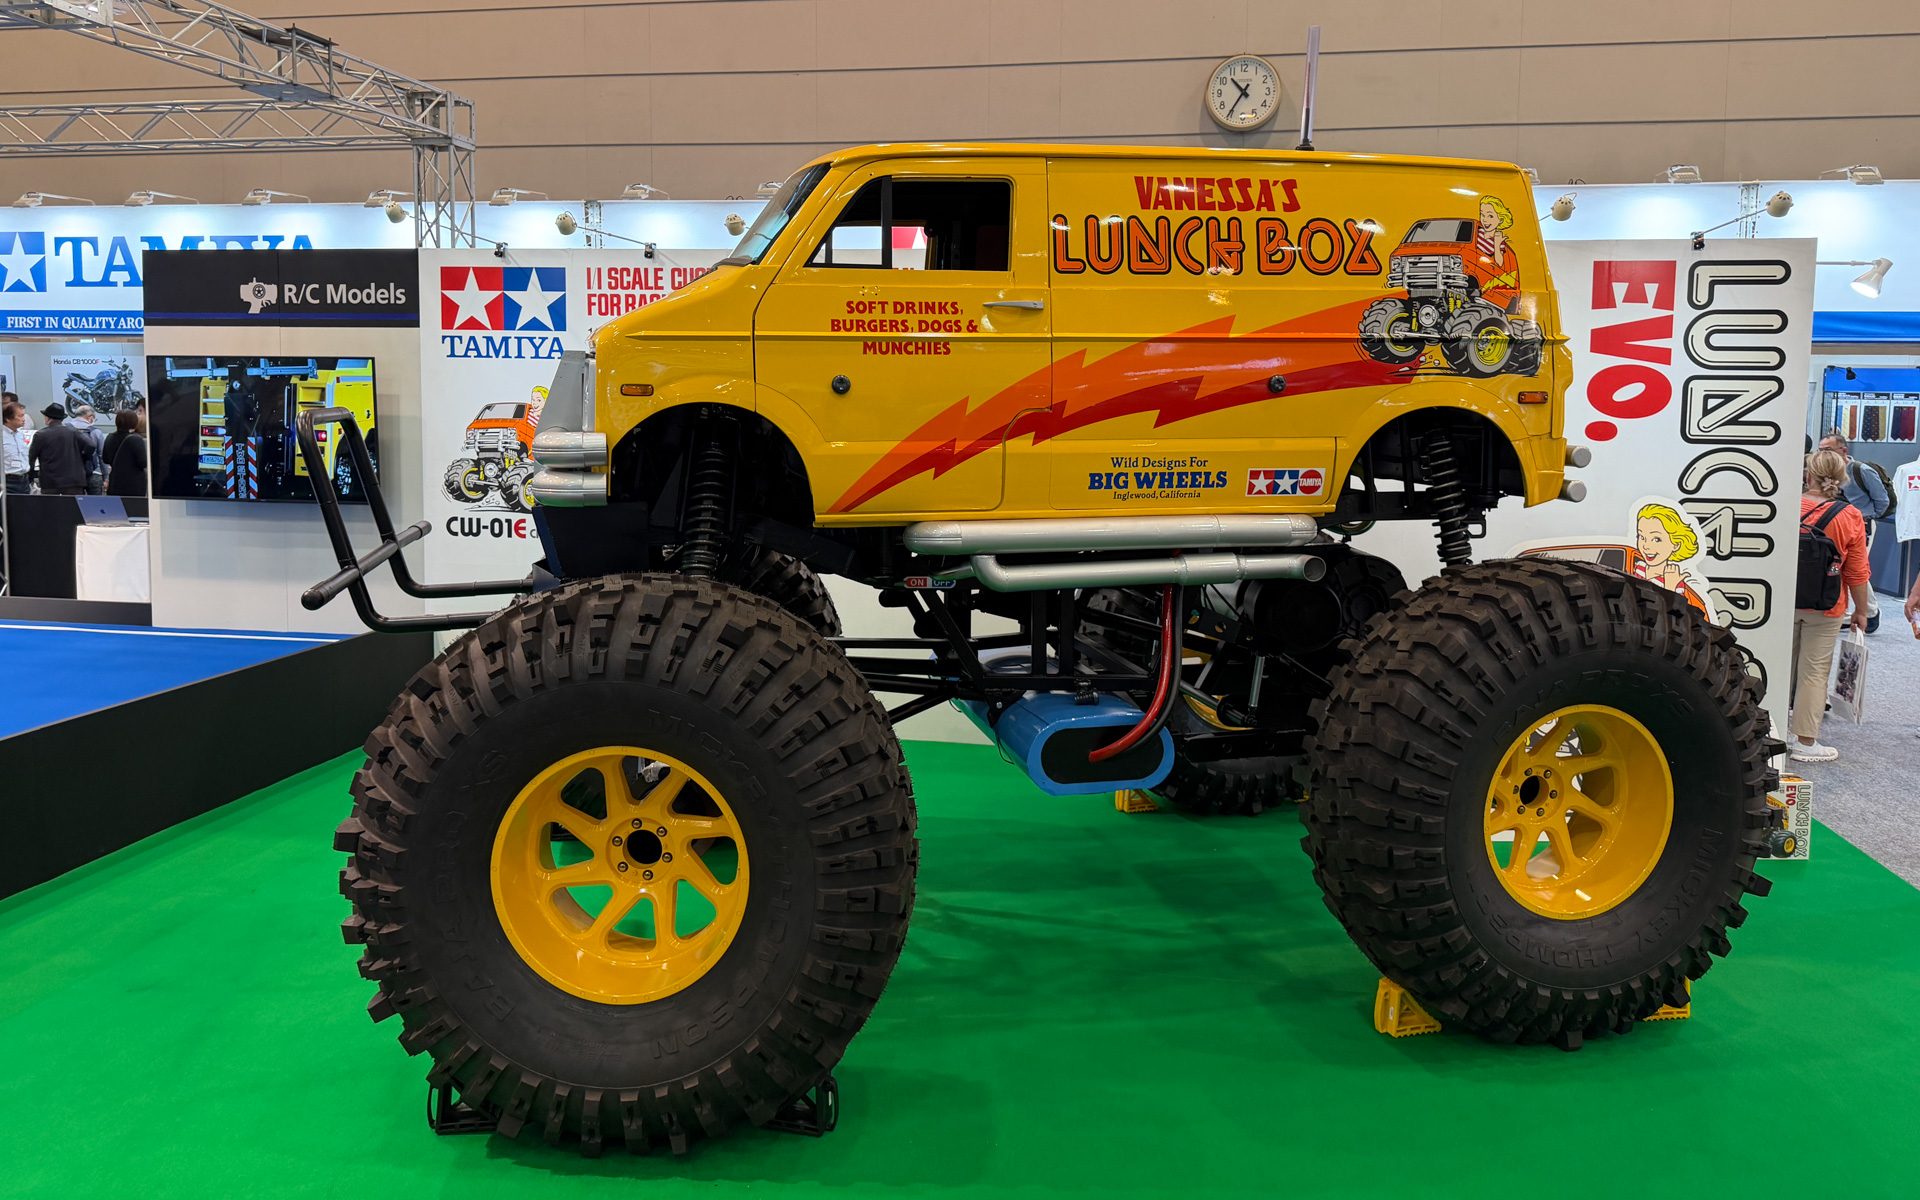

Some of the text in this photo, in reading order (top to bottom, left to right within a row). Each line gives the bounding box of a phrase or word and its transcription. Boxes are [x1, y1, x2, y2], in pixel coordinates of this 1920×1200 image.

[1240, 63, 1249, 73] 12
[1219, 76, 1227, 86] 10
[1262, 74, 1268, 84] 2
[1216, 89, 1222, 98] 9
[1264, 87, 1271, 96] 3
[1219, 101, 1226, 110] 8
[1260, 99, 1267, 108] 4
[1134, 175, 1303, 213] VANESSA'S
[1050, 213, 1383, 276] LUNCH BOX
[607, 267, 664, 291] SCALE
[283, 281, 407, 305] R/C Models
[587, 293, 621, 317] FOR
[845, 300, 964, 316] SOFT DRINKS,
[6, 316, 42, 329] FIRST
[44, 316, 59, 329] IN
[61, 316, 118, 331] QUALITY
[830, 318, 979, 333] BURGERS, DOGS &
[442, 335, 565, 360] TAMIYA
[862, 341, 951, 356] MUNCHIES
[1585, 260, 1677, 442] EVO.
[1678, 259, 1792, 561] LUNCH
[1110, 456, 1209, 470] Wild Designs For
[1088, 470, 1228, 490] BIG WHEELS
[1298, 477, 1323, 487] TAMIYA
[1112, 489, 1201, 501] Inglewood, California
[446, 516, 527, 539] CW-01E
[909, 578, 924, 587] ON
[1794, 784, 1811, 857] LUNCH BOX
